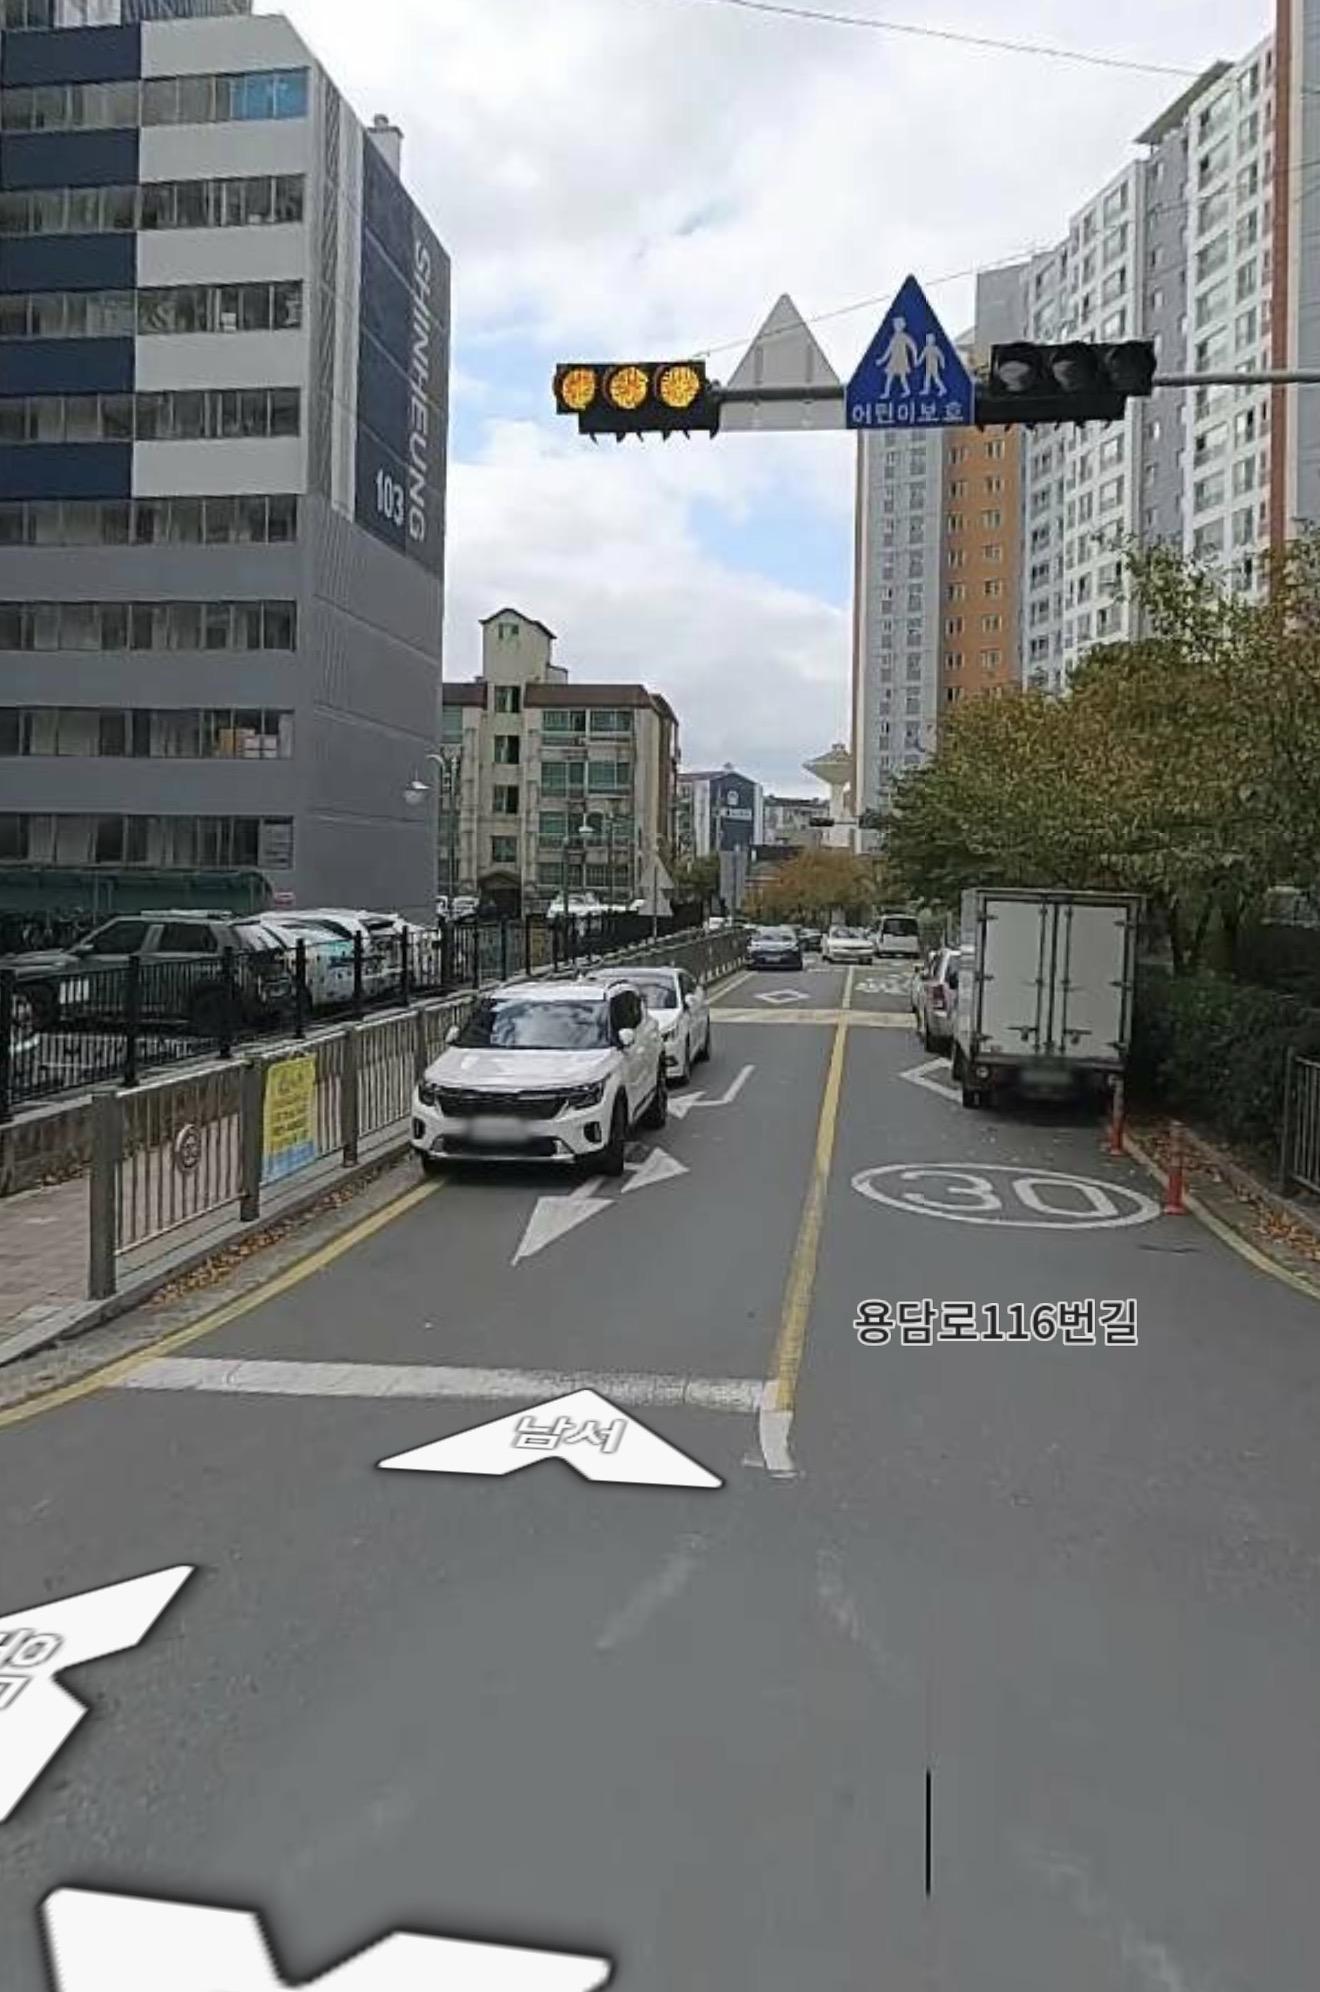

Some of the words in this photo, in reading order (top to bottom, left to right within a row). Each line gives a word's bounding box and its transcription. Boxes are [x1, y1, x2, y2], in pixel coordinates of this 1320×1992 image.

[409, 241, 431, 542] SHINHEUNG
[852, 401, 964, 425] 어린이보호
[376, 468, 405, 527] 103
[900, 1169, 1119, 1219] 30
